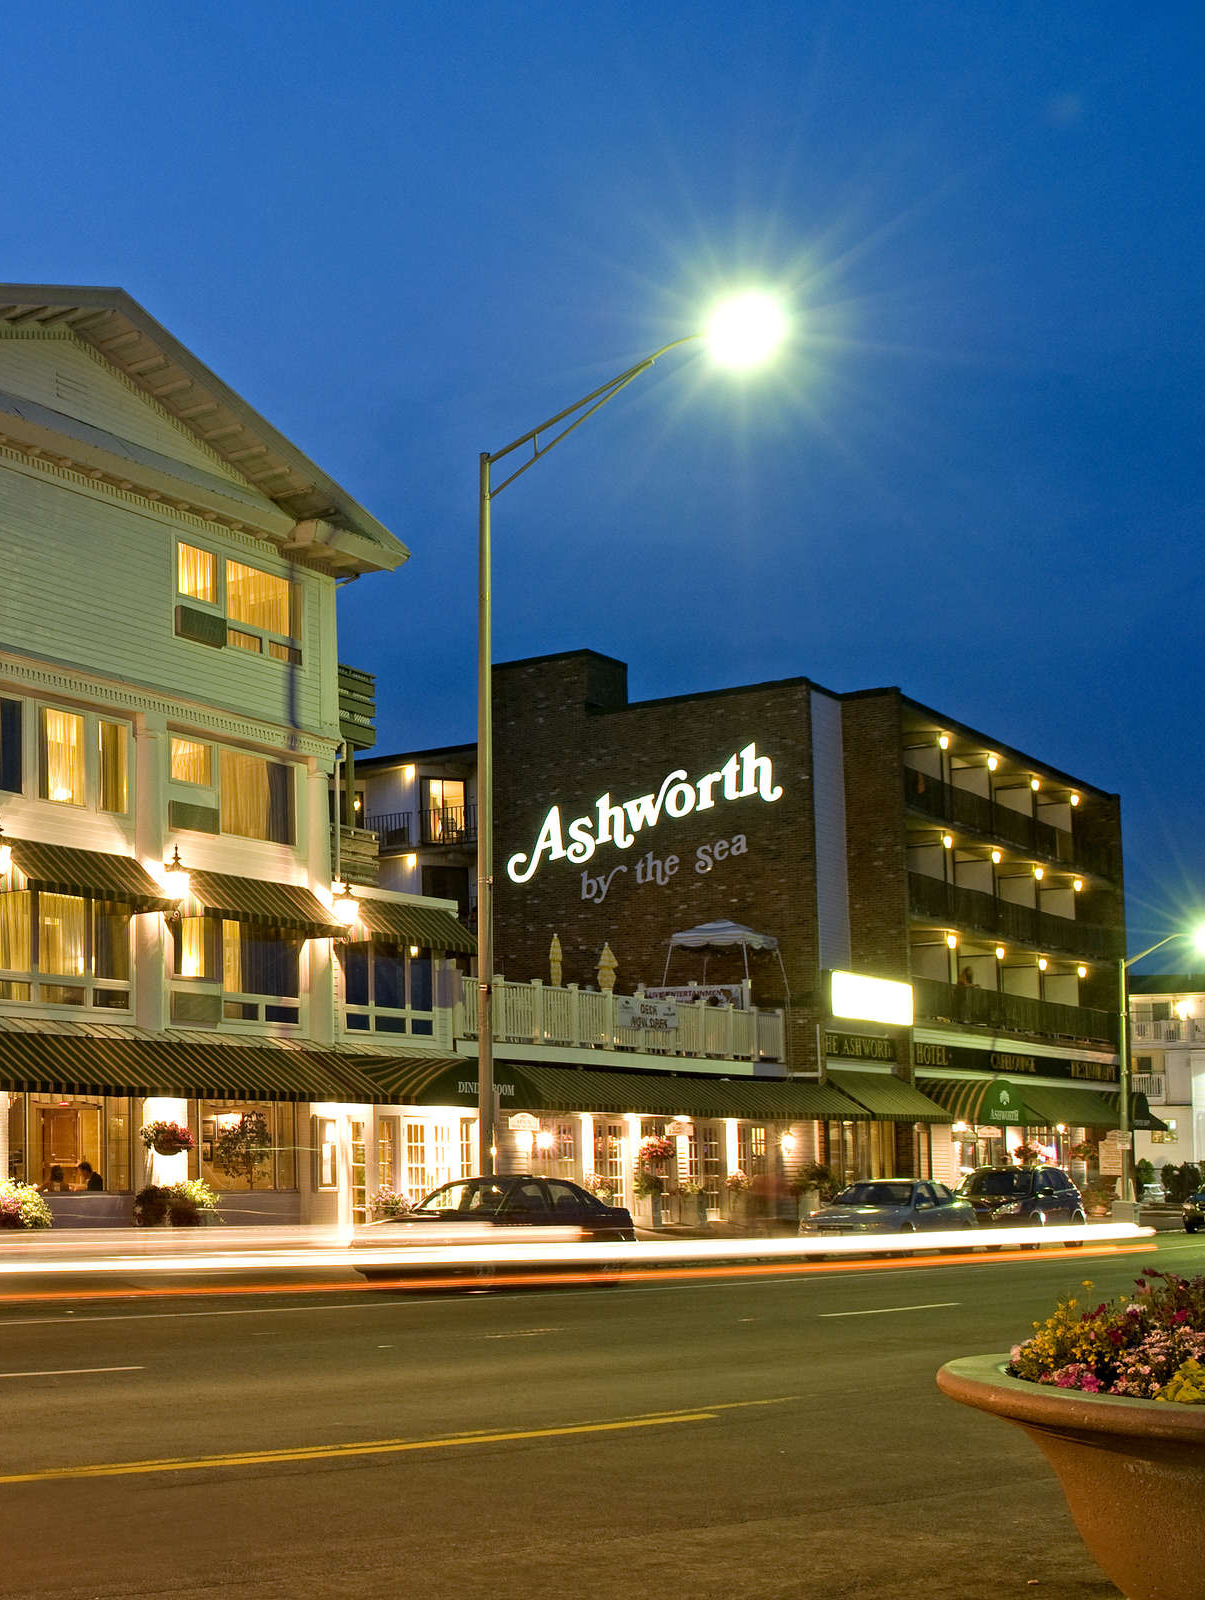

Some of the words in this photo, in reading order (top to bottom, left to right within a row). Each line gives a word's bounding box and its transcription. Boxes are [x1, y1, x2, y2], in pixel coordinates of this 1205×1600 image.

[507, 741, 784, 884] Ashworth
[580, 865, 628, 905] by
[634, 850, 681, 887] the
[694, 833, 749, 875] sea
[665, 989, 723, 998] ENTERTAINMEN
[641, 1004, 657, 1016] DECK
[915, 1043, 949, 1066] HOTEL
[458, 1080, 480, 1095] DINI
[491, 1083, 515, 1097] ROOM
